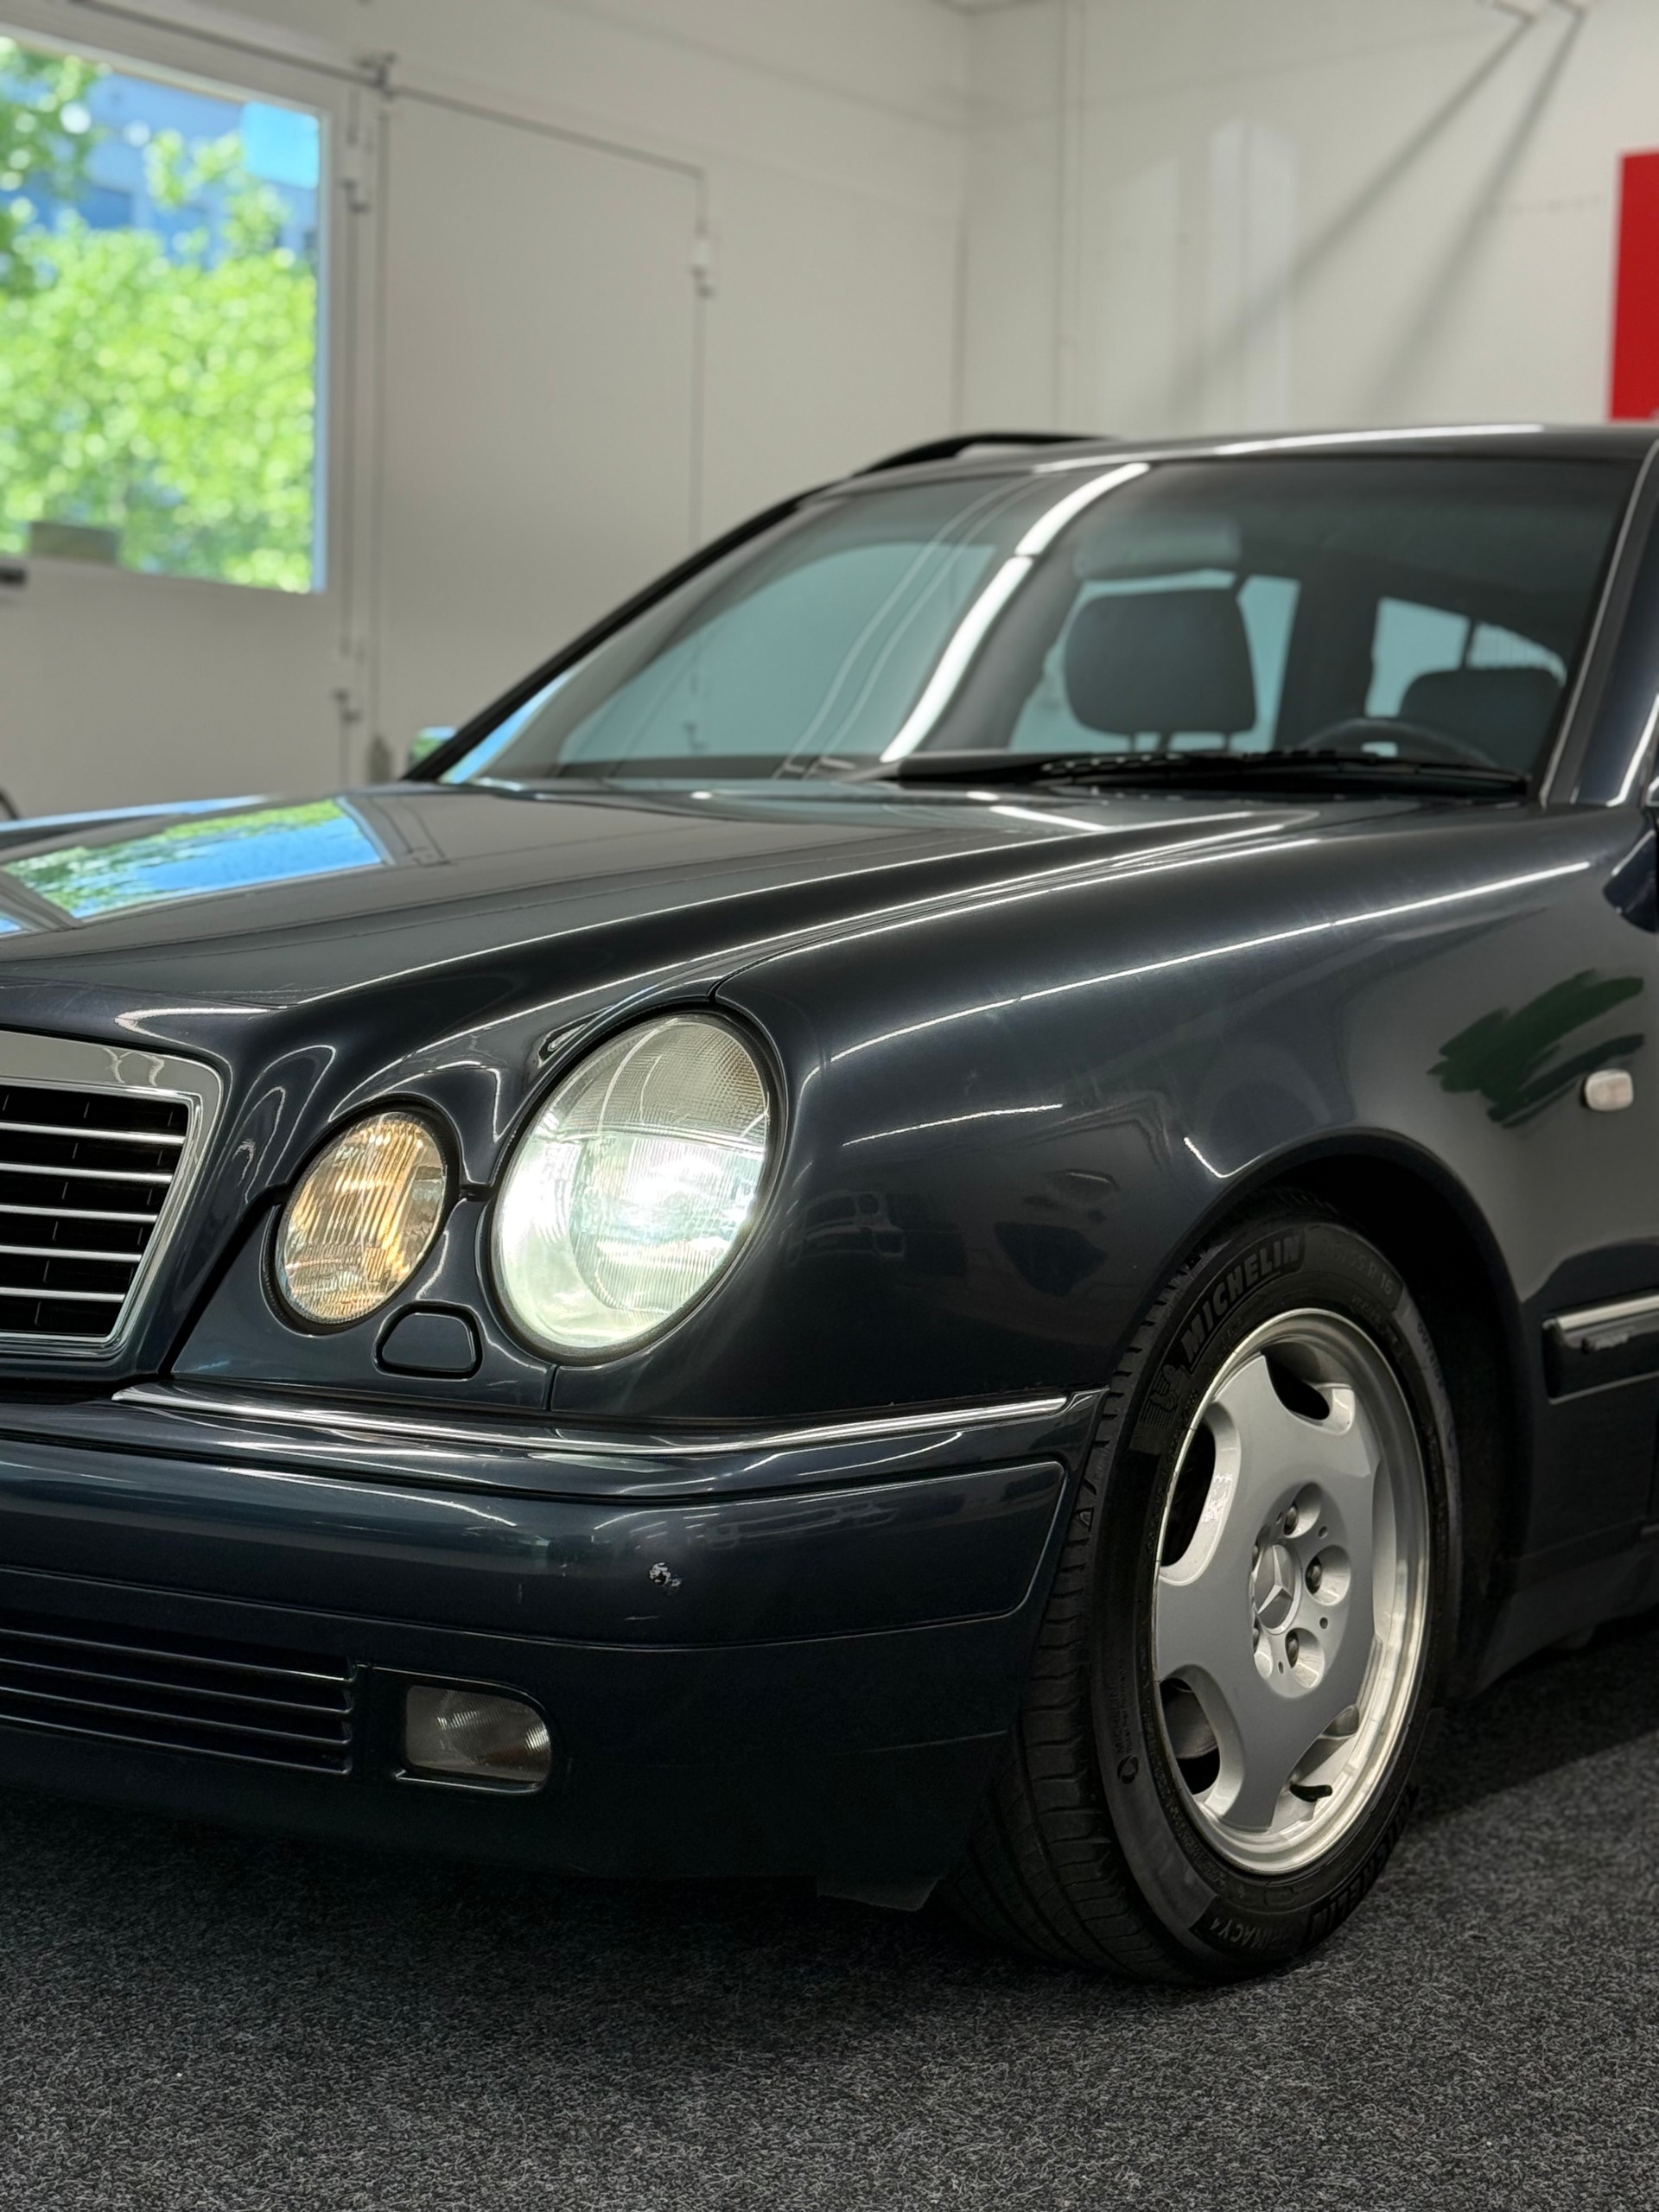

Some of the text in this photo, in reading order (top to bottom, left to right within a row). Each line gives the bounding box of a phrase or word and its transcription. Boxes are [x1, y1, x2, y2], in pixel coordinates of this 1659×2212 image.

[1180, 1235, 1300, 1363] MICHELIN
[1380, 1272, 1394, 1295] 16
[1109, 1685, 1124, 1754] MICHELIN
